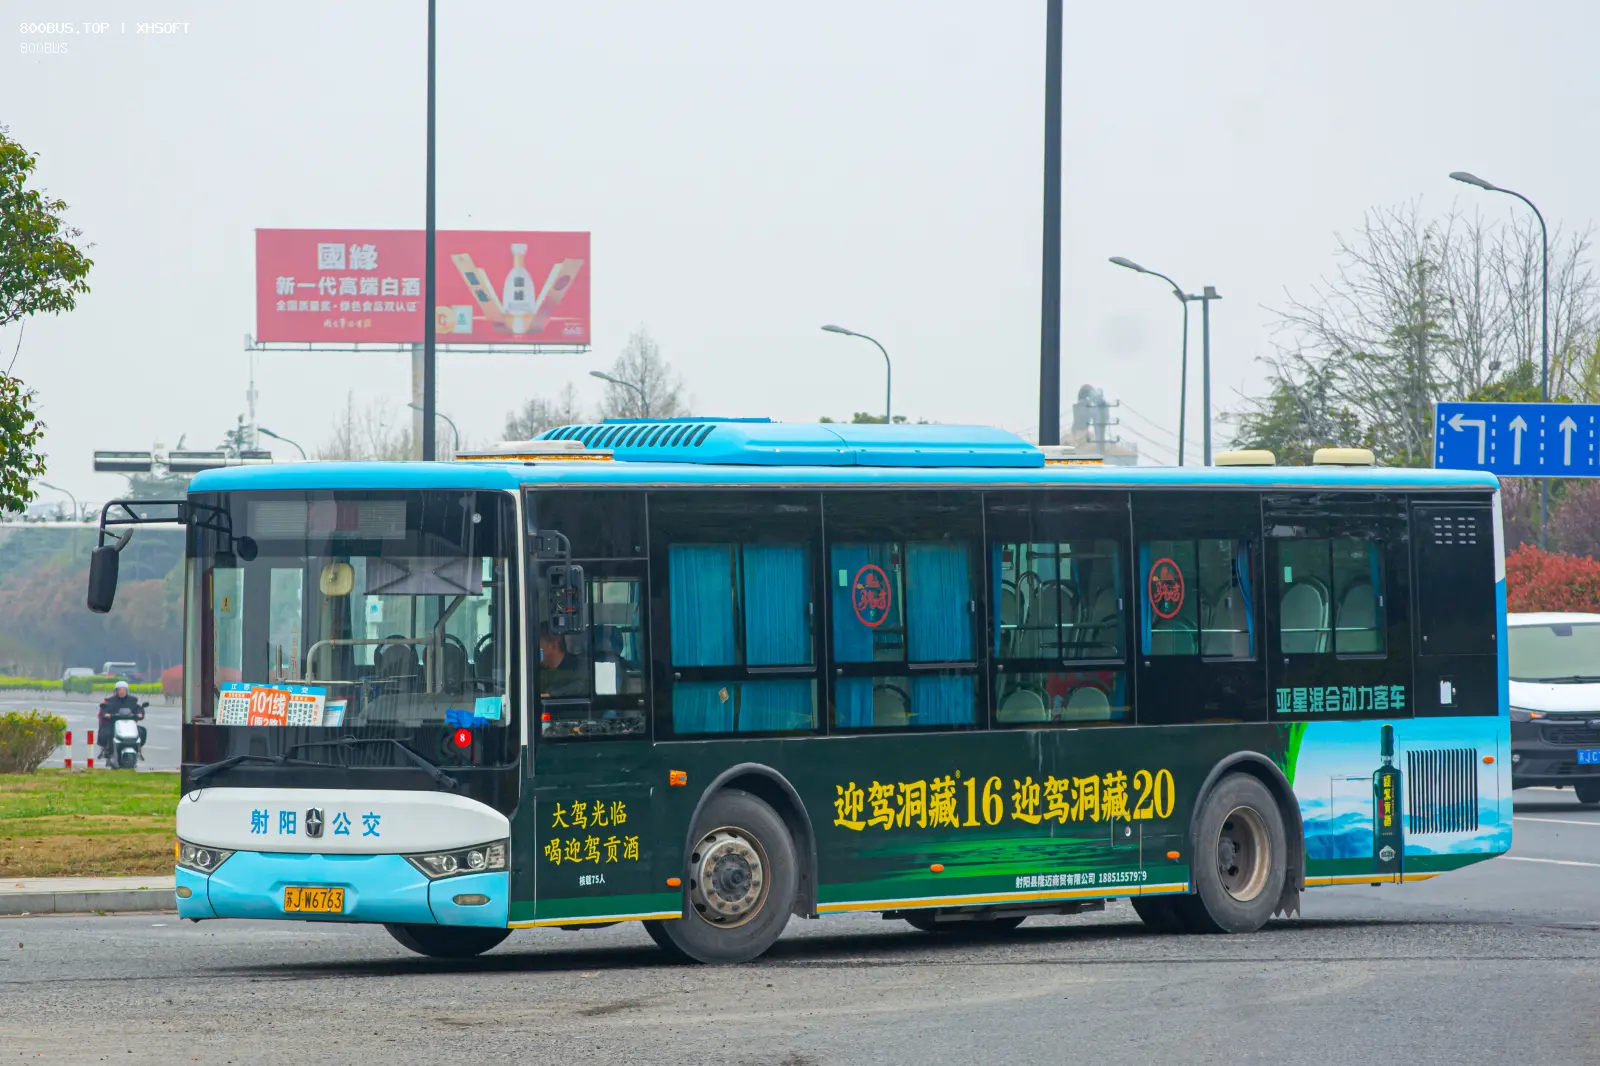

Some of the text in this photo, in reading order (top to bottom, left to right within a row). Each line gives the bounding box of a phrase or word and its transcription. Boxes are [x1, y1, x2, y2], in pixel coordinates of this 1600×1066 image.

[275, 276, 421, 297] 新一代高端白酒
[231, 683, 309, 694] 江苏公交
[1276, 685, 1405, 713] 亚星混合动力客车
[251, 690, 287, 717] 101线
[459, 733, 467, 744] 8
[1011, 768, 1176, 826] 迎驾洞藏20
[551, 800, 627, 829] 大驾光临
[544, 835, 639, 865] 喝迎驾贡酒
